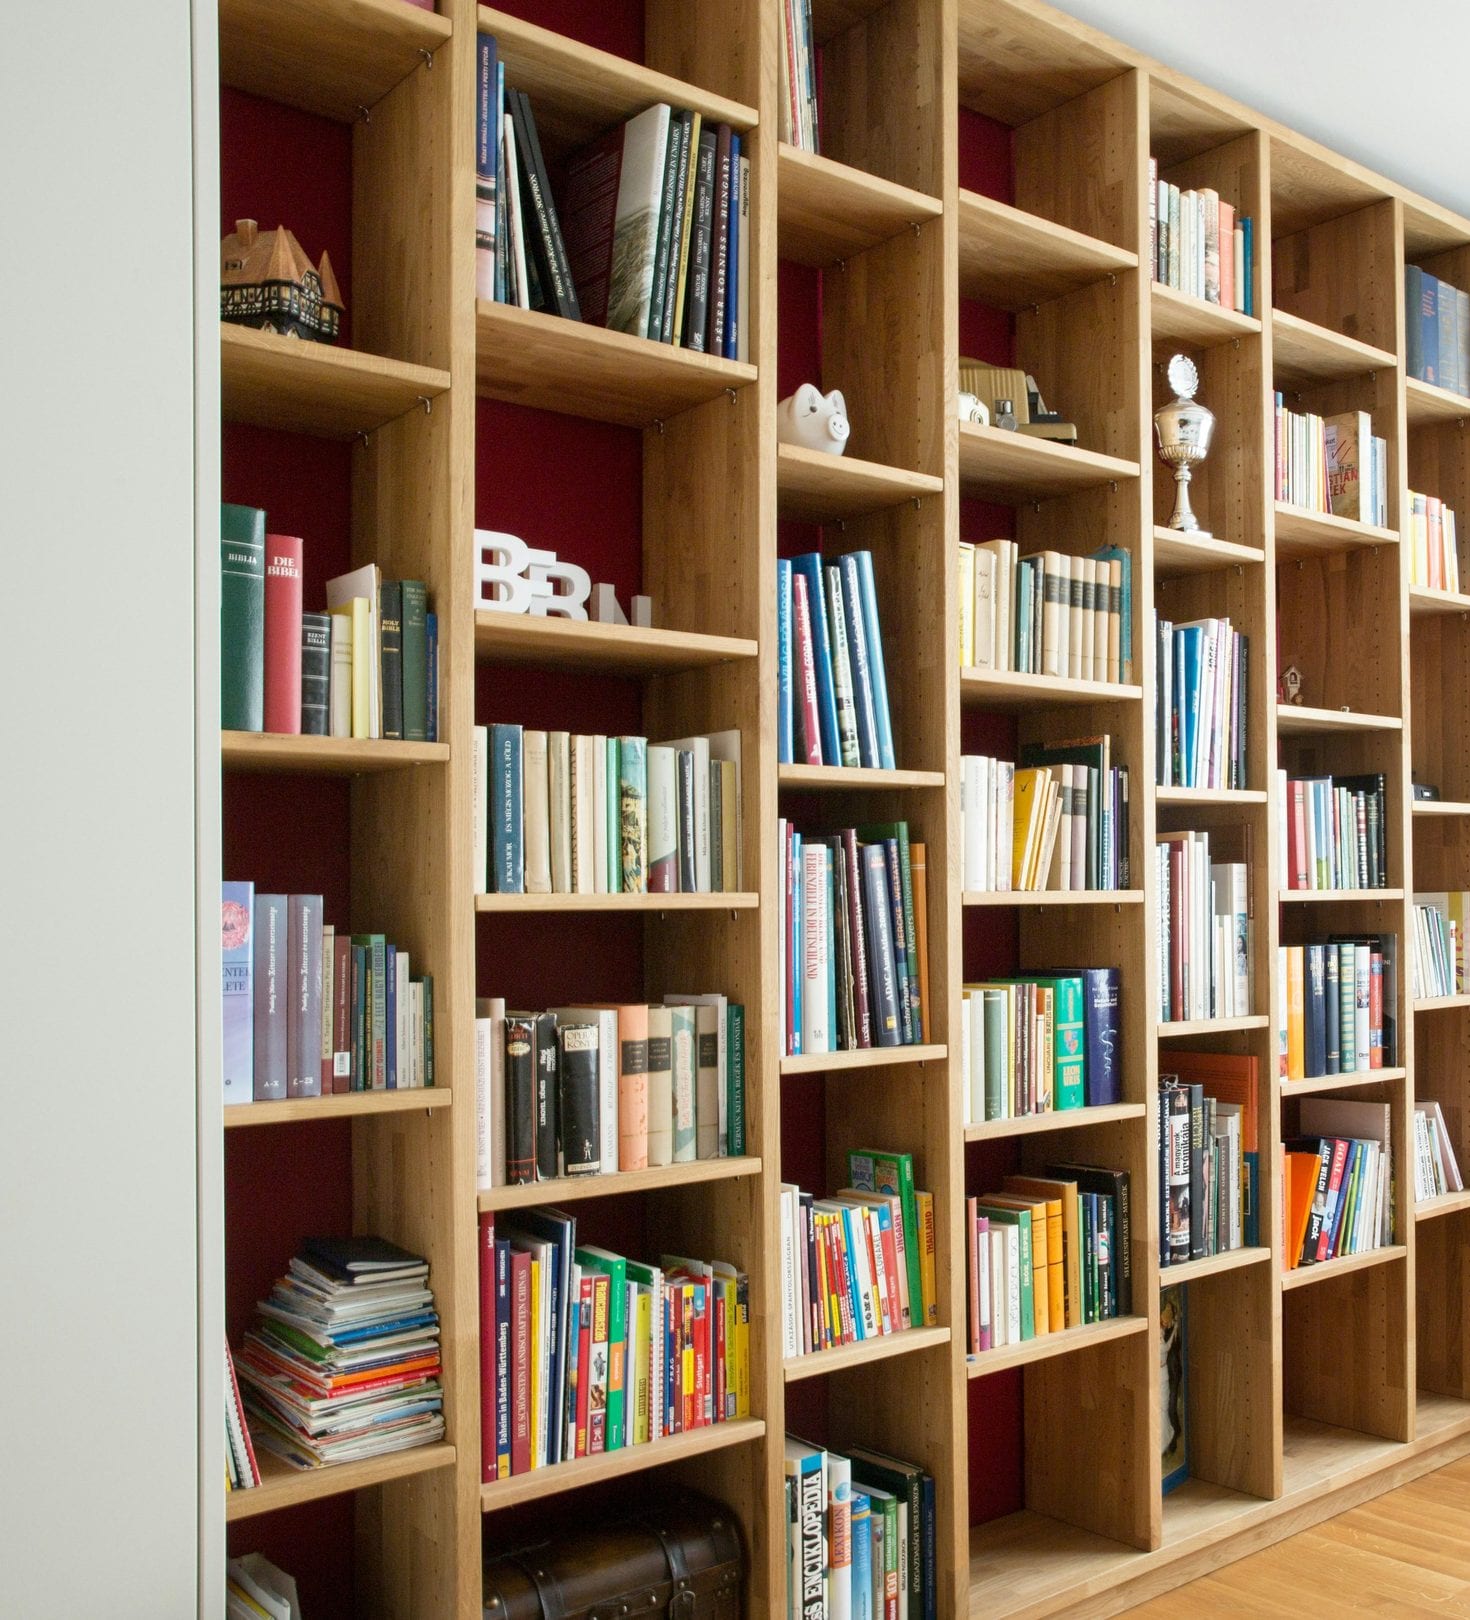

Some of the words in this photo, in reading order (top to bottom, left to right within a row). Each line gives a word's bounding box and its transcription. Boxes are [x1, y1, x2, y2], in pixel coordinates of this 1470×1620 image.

[670, 126, 680, 158] UNGARN
[676, 158, 688, 198] SCHLÖSSER
[682, 121, 690, 148] UNGARN
[669, 158, 677, 168] IN
[528, 173, 543, 209] SOPRON
[666, 168, 677, 211] SCHLÖSSER
[721, 154, 730, 218] HUNGARY
[718, 236, 727, 294] KORNISS
[714, 301, 724, 343] PÉTER
[228, 553, 258, 564] BIBLIA
[267, 566, 300, 578] BIBEL
[273, 556, 295, 566] DIE
[780, 569, 788, 641] FŐVÁROSAI
[780, 648, 788, 682] VILÁG
[782, 683, 788, 692] A
[503, 740, 512, 761] FÖLD
[504, 770, 512, 798] MOZOG
[504, 798, 512, 824] MÉGIS
[806, 853, 817, 904] FERIENZIELE
[890, 846, 902, 902] WELTATLAS
[901, 840, 914, 914] Universalatlas
[806, 907, 817, 917] IN
[895, 906, 906, 949] DIERCKE
[806, 919, 818, 979] DEUTSCHLAND
[906, 915, 917, 953] Meyers
[374, 979, 384, 999] NAGY
[883, 974, 894, 1002] ADAC
[901, 976, 913, 1040] westermann
[1174, 1131, 1182, 1169] magyarok
[1180, 1122, 1190, 1174] krónikája
[1321, 1146, 1331, 1165] JACK
[1333, 1143, 1346, 1174] GOAL
[1318, 1166, 1328, 1192] WELCH
[894, 1214, 904, 1253] UNGARN
[925, 1211, 934, 1256] THAILAND
[843, 1256, 851, 1286] BLANCA
[873, 1234, 885, 1277] SLOWAKEI
[517, 1269, 528, 1302] CHINAS
[847, 1288, 855, 1314] COSTA
[517, 1304, 528, 1371] LANDSCHAFTEN
[498, 1322, 509, 1402] Baden-Württemberg
[695, 1354, 704, 1389] Stuttgart
[498, 1403, 508, 1412] in
[516, 1372, 528, 1420] SCHÖNSTEN
[498, 1415, 508, 1445] Daheim
[517, 1422, 528, 1438] DIE
[912, 1482, 920, 1531] KISLEXIKON
[802, 1469, 824, 1601] ENCIKLOPÉDIA
[834, 1509, 845, 1565] LEXIKON
[886, 1571, 897, 1598] 100
